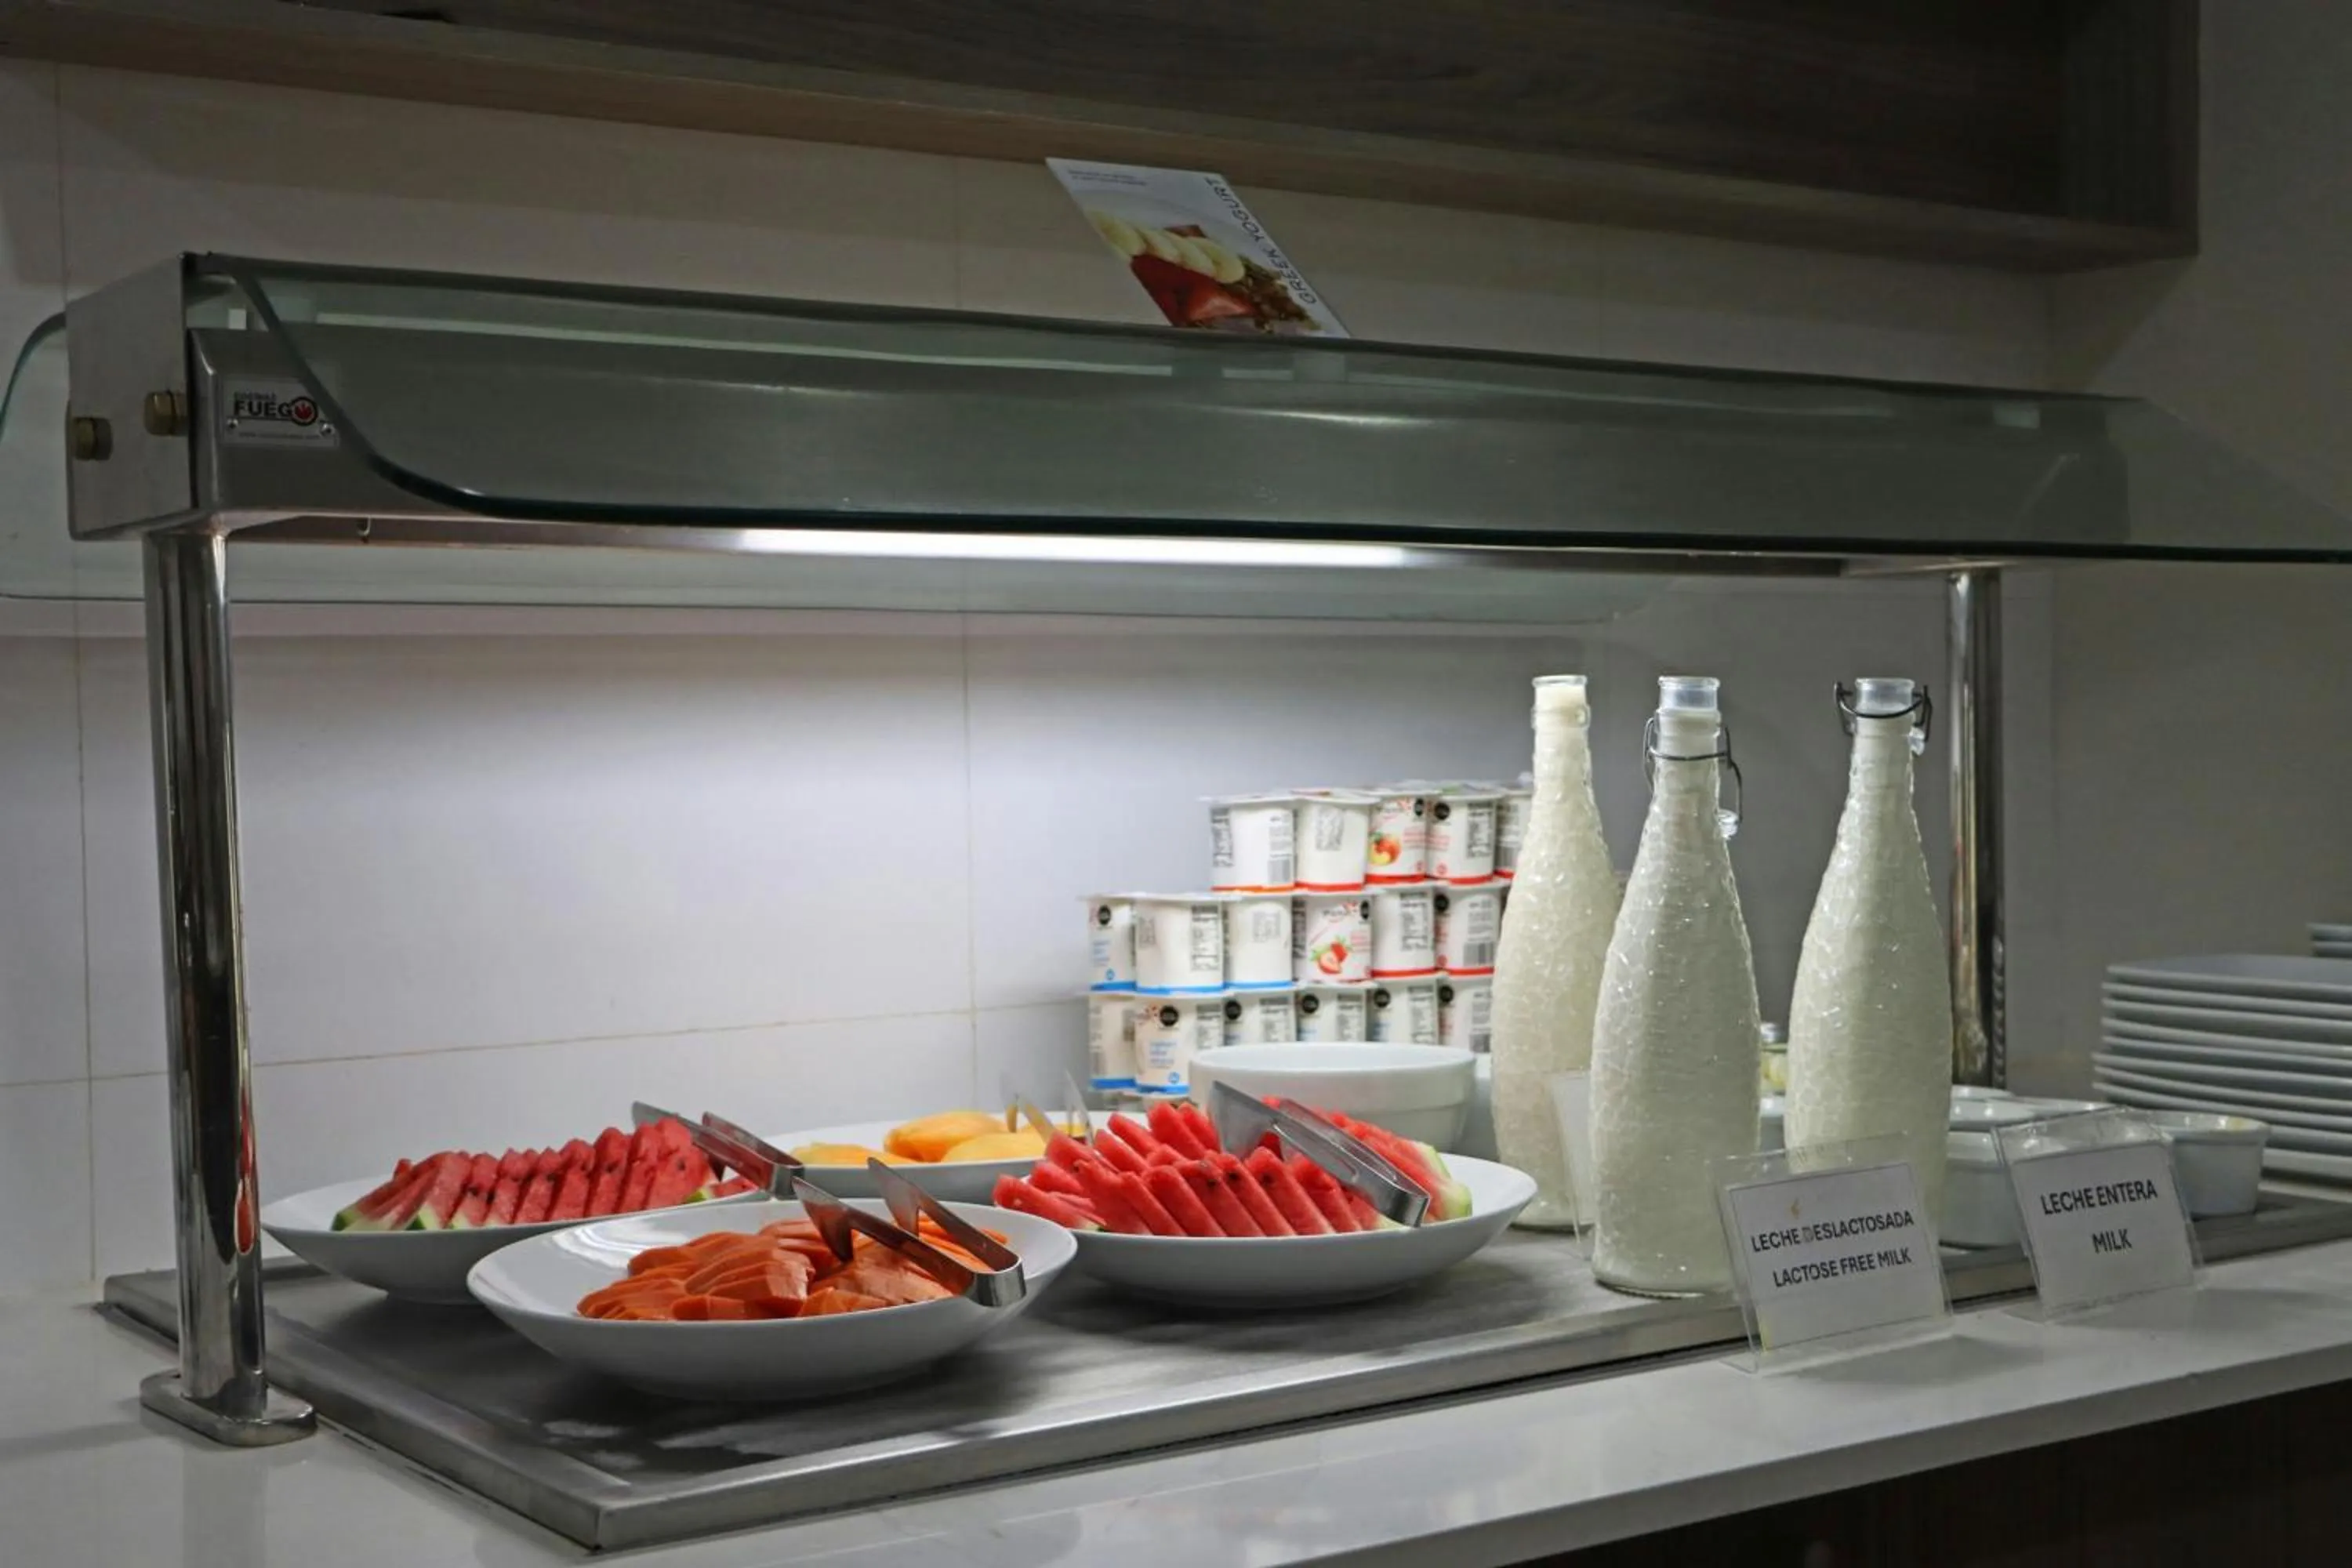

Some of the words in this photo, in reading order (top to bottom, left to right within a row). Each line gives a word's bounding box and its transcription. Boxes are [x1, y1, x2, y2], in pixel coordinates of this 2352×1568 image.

[1203, 176, 1265, 242] YOGURT
[1263, 247, 1317, 304] GREEK
[233, 396, 318, 426] FUEGO
[2040, 1187, 2096, 1216] LECHE
[2096, 1178, 2158, 1207] ENTERA
[1751, 1228, 1802, 1253] LECHE
[1802, 1210, 1915, 1243] DESLACTOSADA
[2092, 1228, 2132, 1254] MILK
[1773, 1259, 1839, 1287] LACTOSE
[1839, 1254, 1876, 1276] FREE
[1876, 1247, 1912, 1268] MILK
